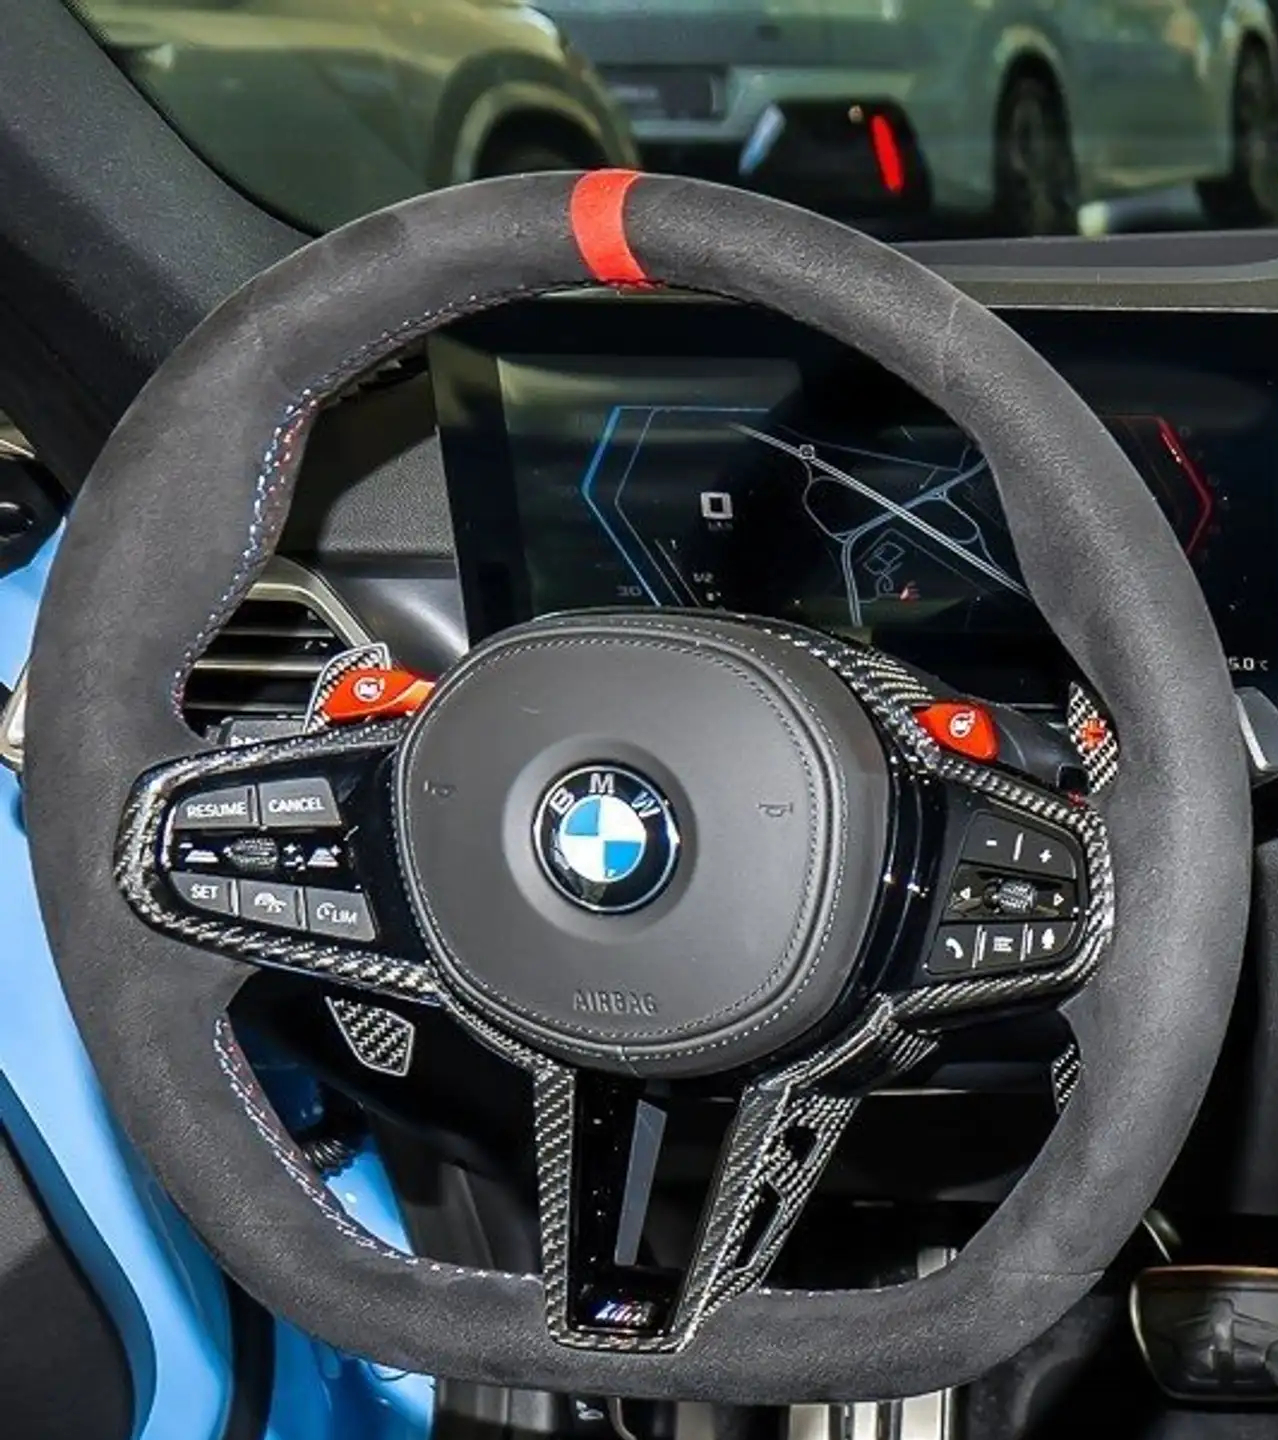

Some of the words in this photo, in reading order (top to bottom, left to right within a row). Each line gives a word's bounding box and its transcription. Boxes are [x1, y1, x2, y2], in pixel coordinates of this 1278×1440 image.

[550, 773, 660, 818] BMW
[187, 801, 247, 818] RESUME
[268, 797, 325, 813] CANCEL
[191, 883, 219, 900] SET
[332, 910, 357, 924] LIM
[573, 989, 657, 1016] AIRBAG
